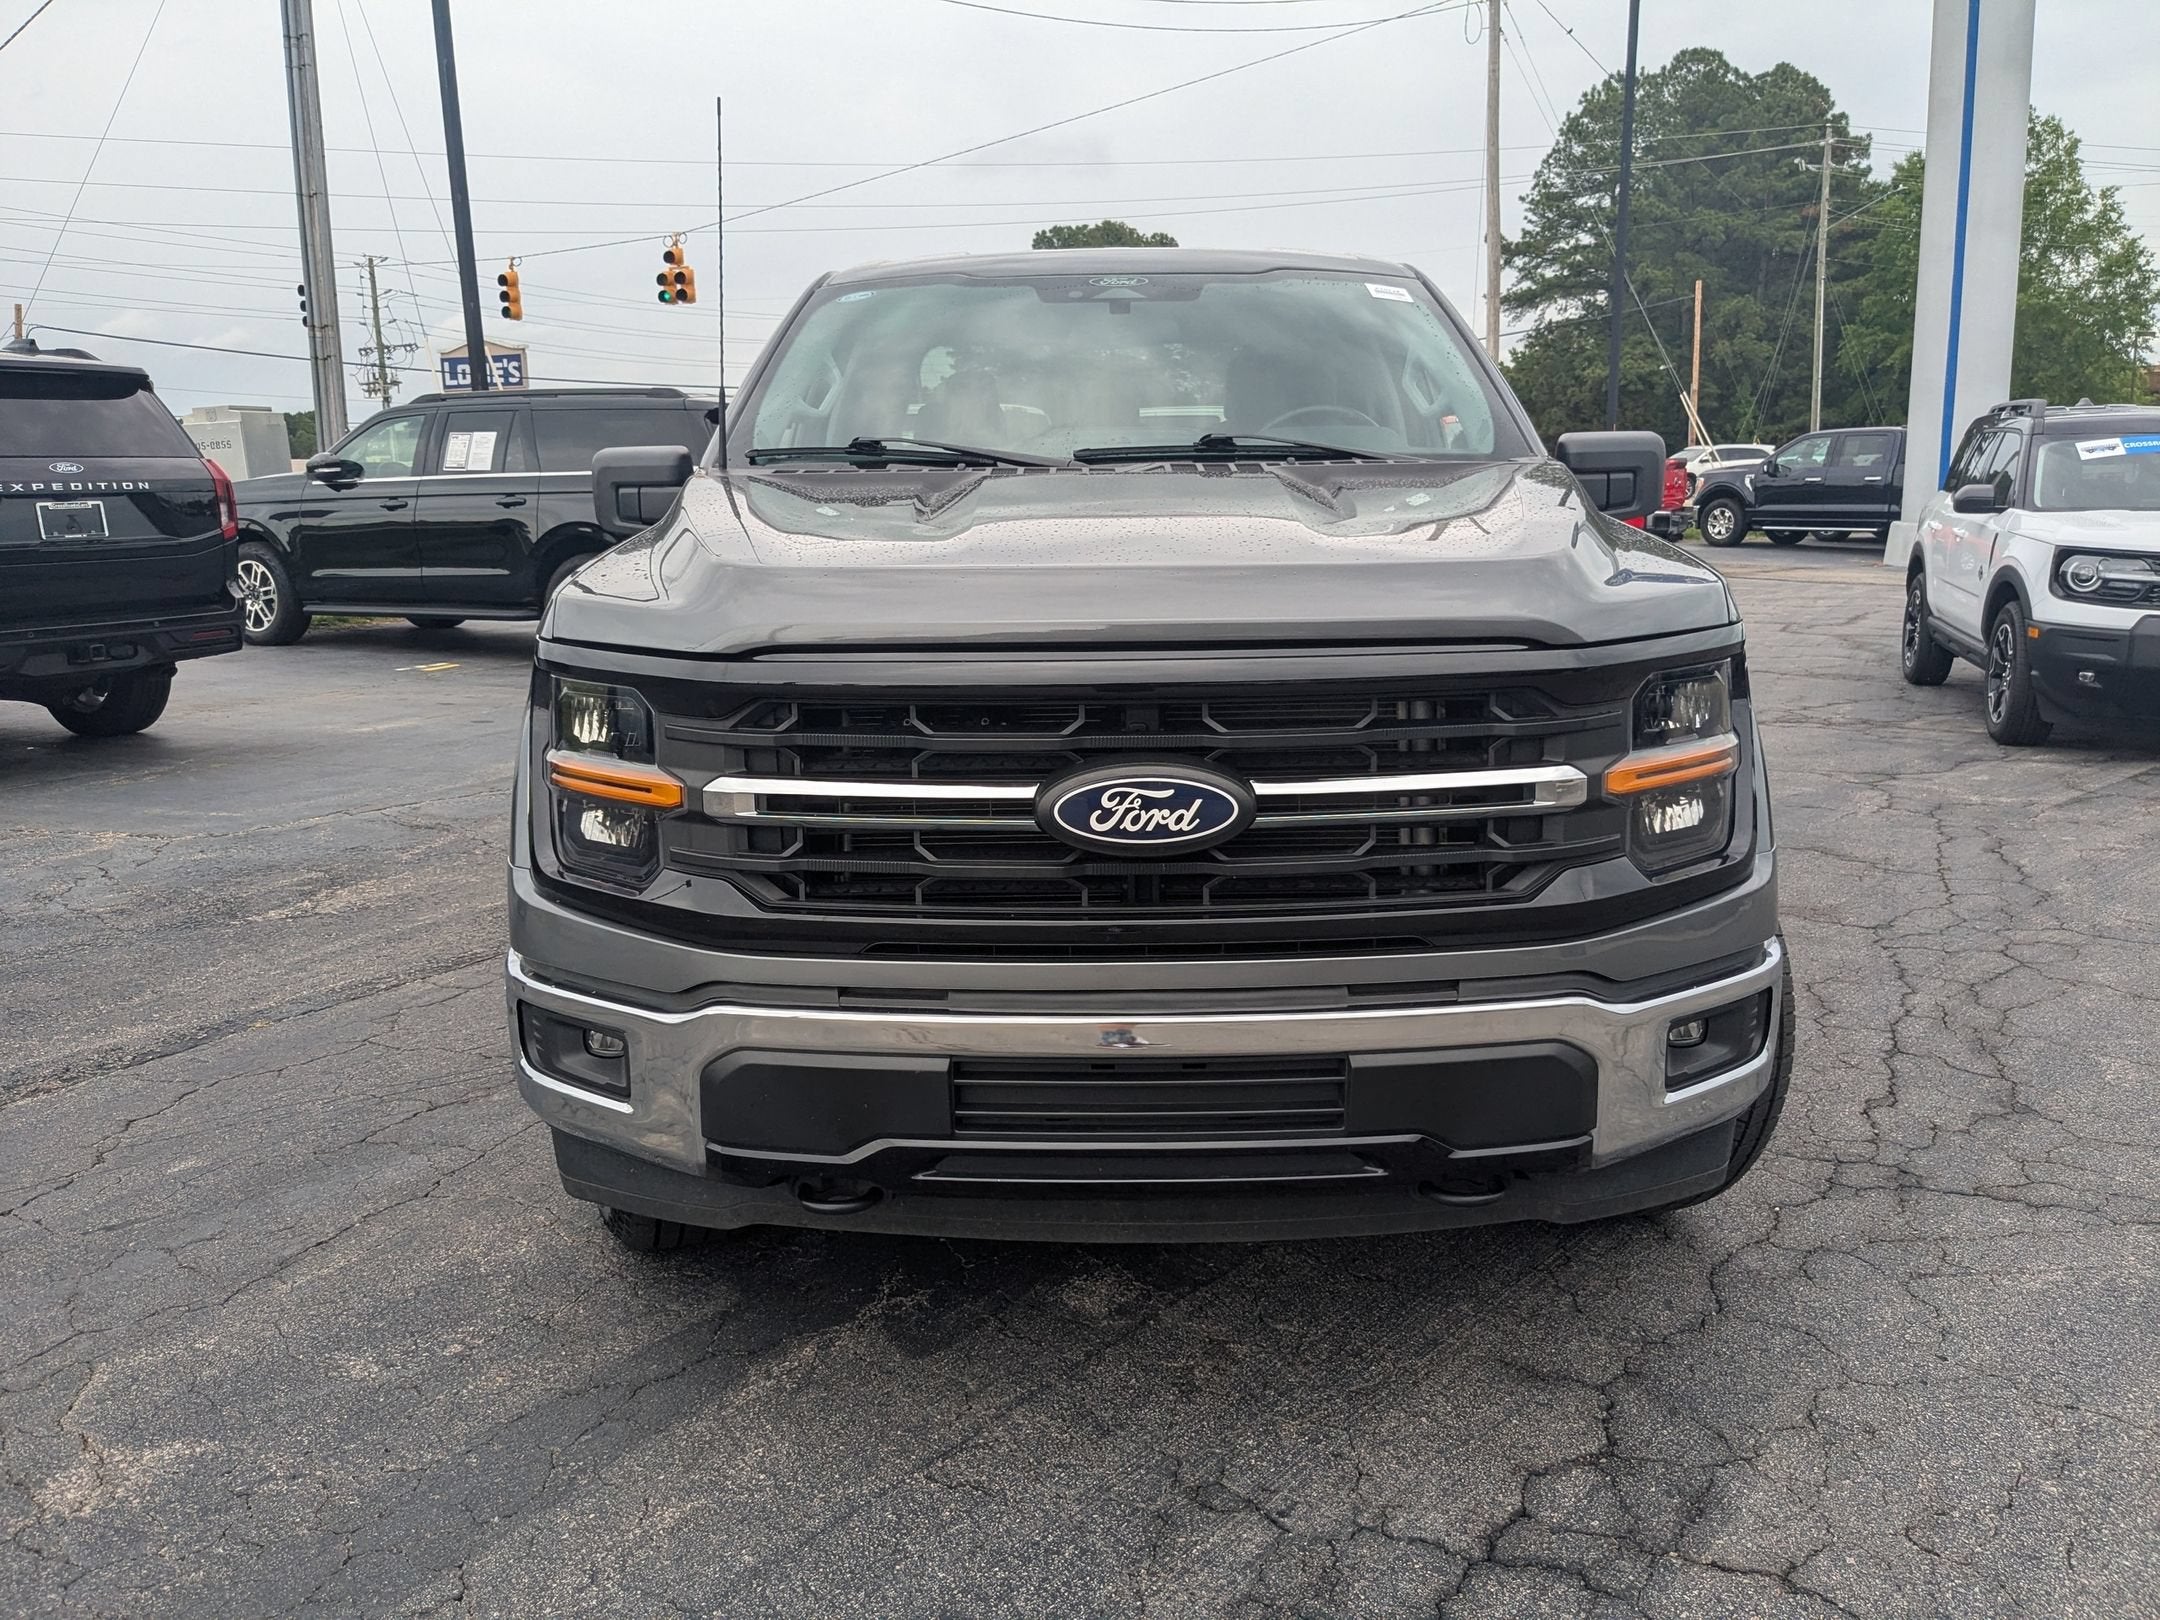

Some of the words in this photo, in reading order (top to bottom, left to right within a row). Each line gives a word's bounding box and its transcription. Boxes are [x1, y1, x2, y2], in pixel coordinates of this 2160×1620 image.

[443, 359, 521, 386] LOE'S
[2123, 440, 2160, 449] CROSSR
[0, 481, 150, 492] XPEDITION
[1089, 787, 1203, 832] Ford
